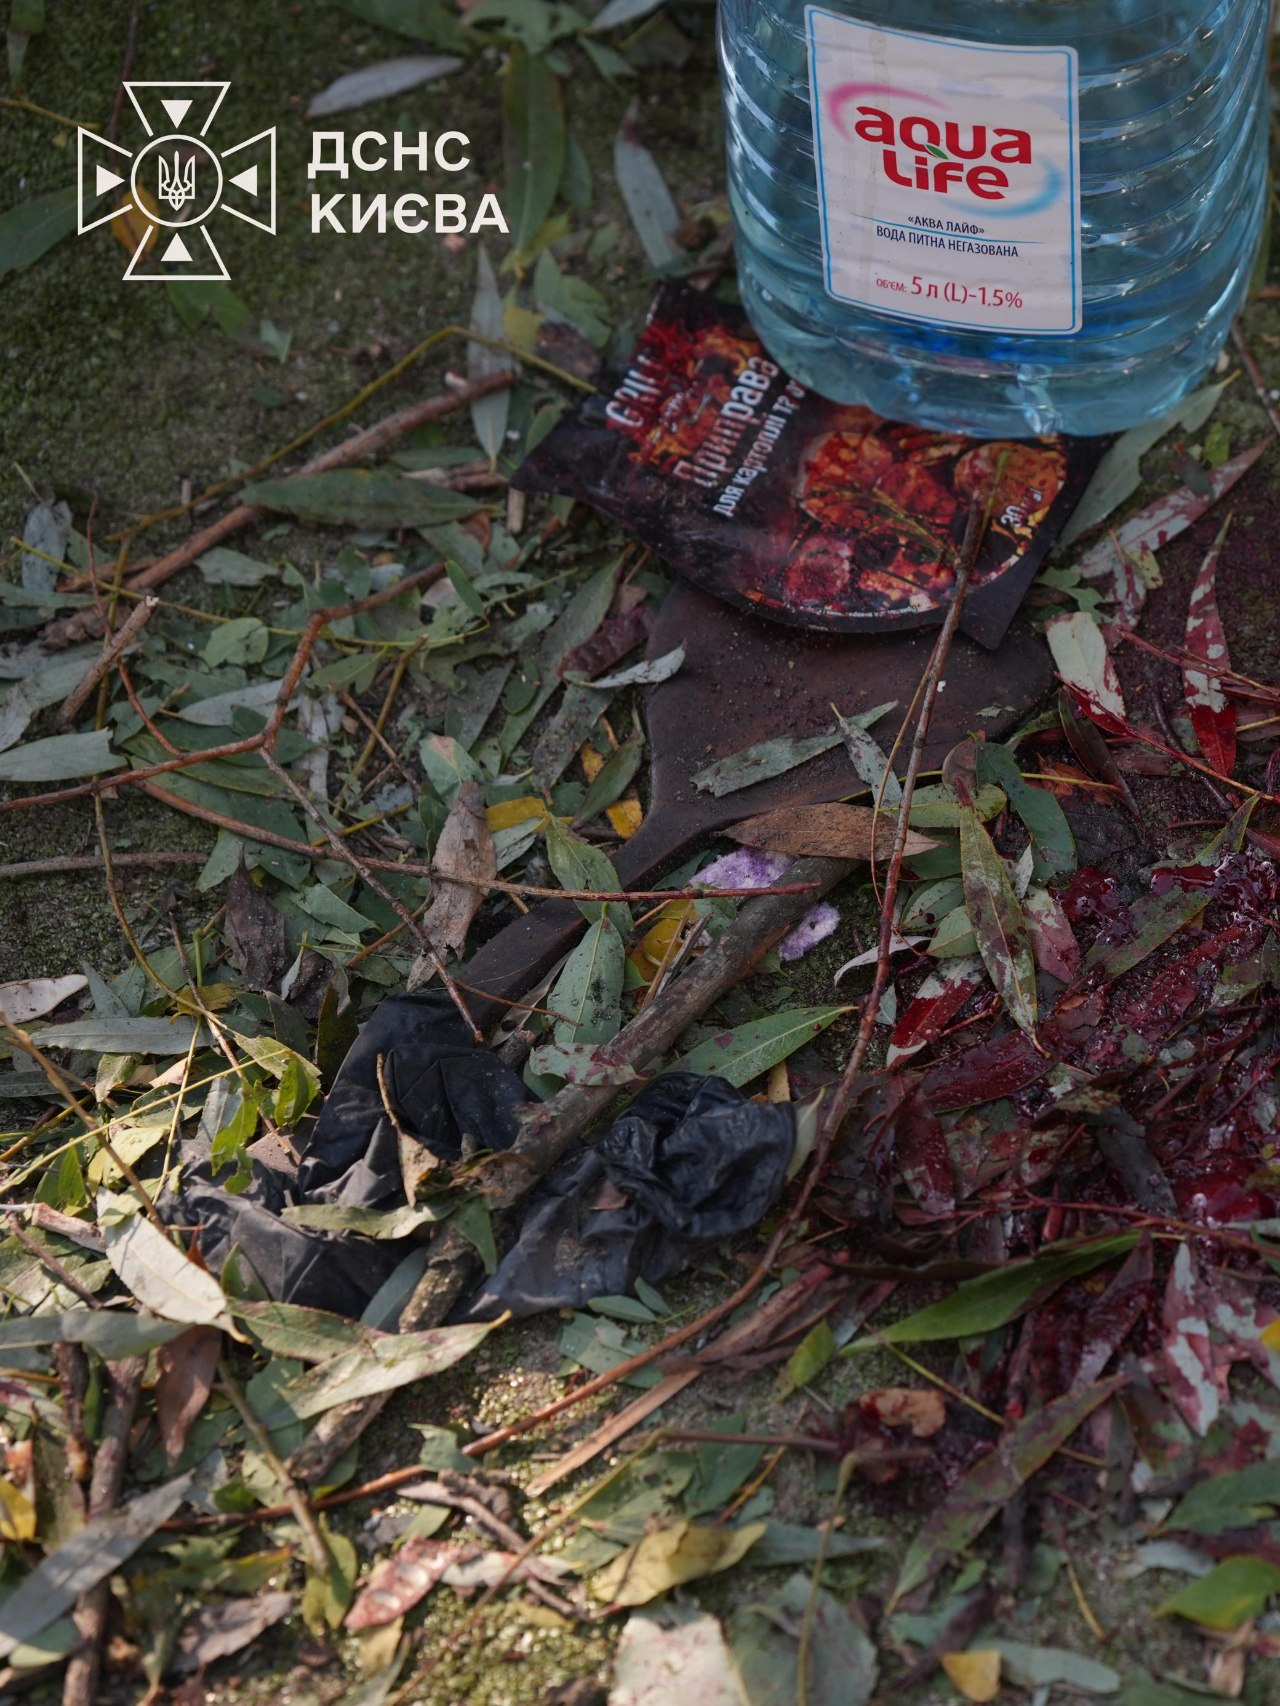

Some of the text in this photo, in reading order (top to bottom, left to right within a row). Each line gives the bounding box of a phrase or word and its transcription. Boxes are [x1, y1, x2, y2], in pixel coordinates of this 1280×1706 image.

[855, 106, 1031, 164] aqua
[883, 149, 1009, 200] Life
[877, 225, 1019, 257] ВОДА ПИТНА НЕГАЗОВАНА
[908, 216, 985, 235] «АКВА ЛАЙФ»
[911, 276, 922, 295] 5
[927, 284, 938, 298] л
[673, 357, 780, 488] Приправа
[713, 485, 745, 518] для
[732, 412, 787, 486] картоплі
